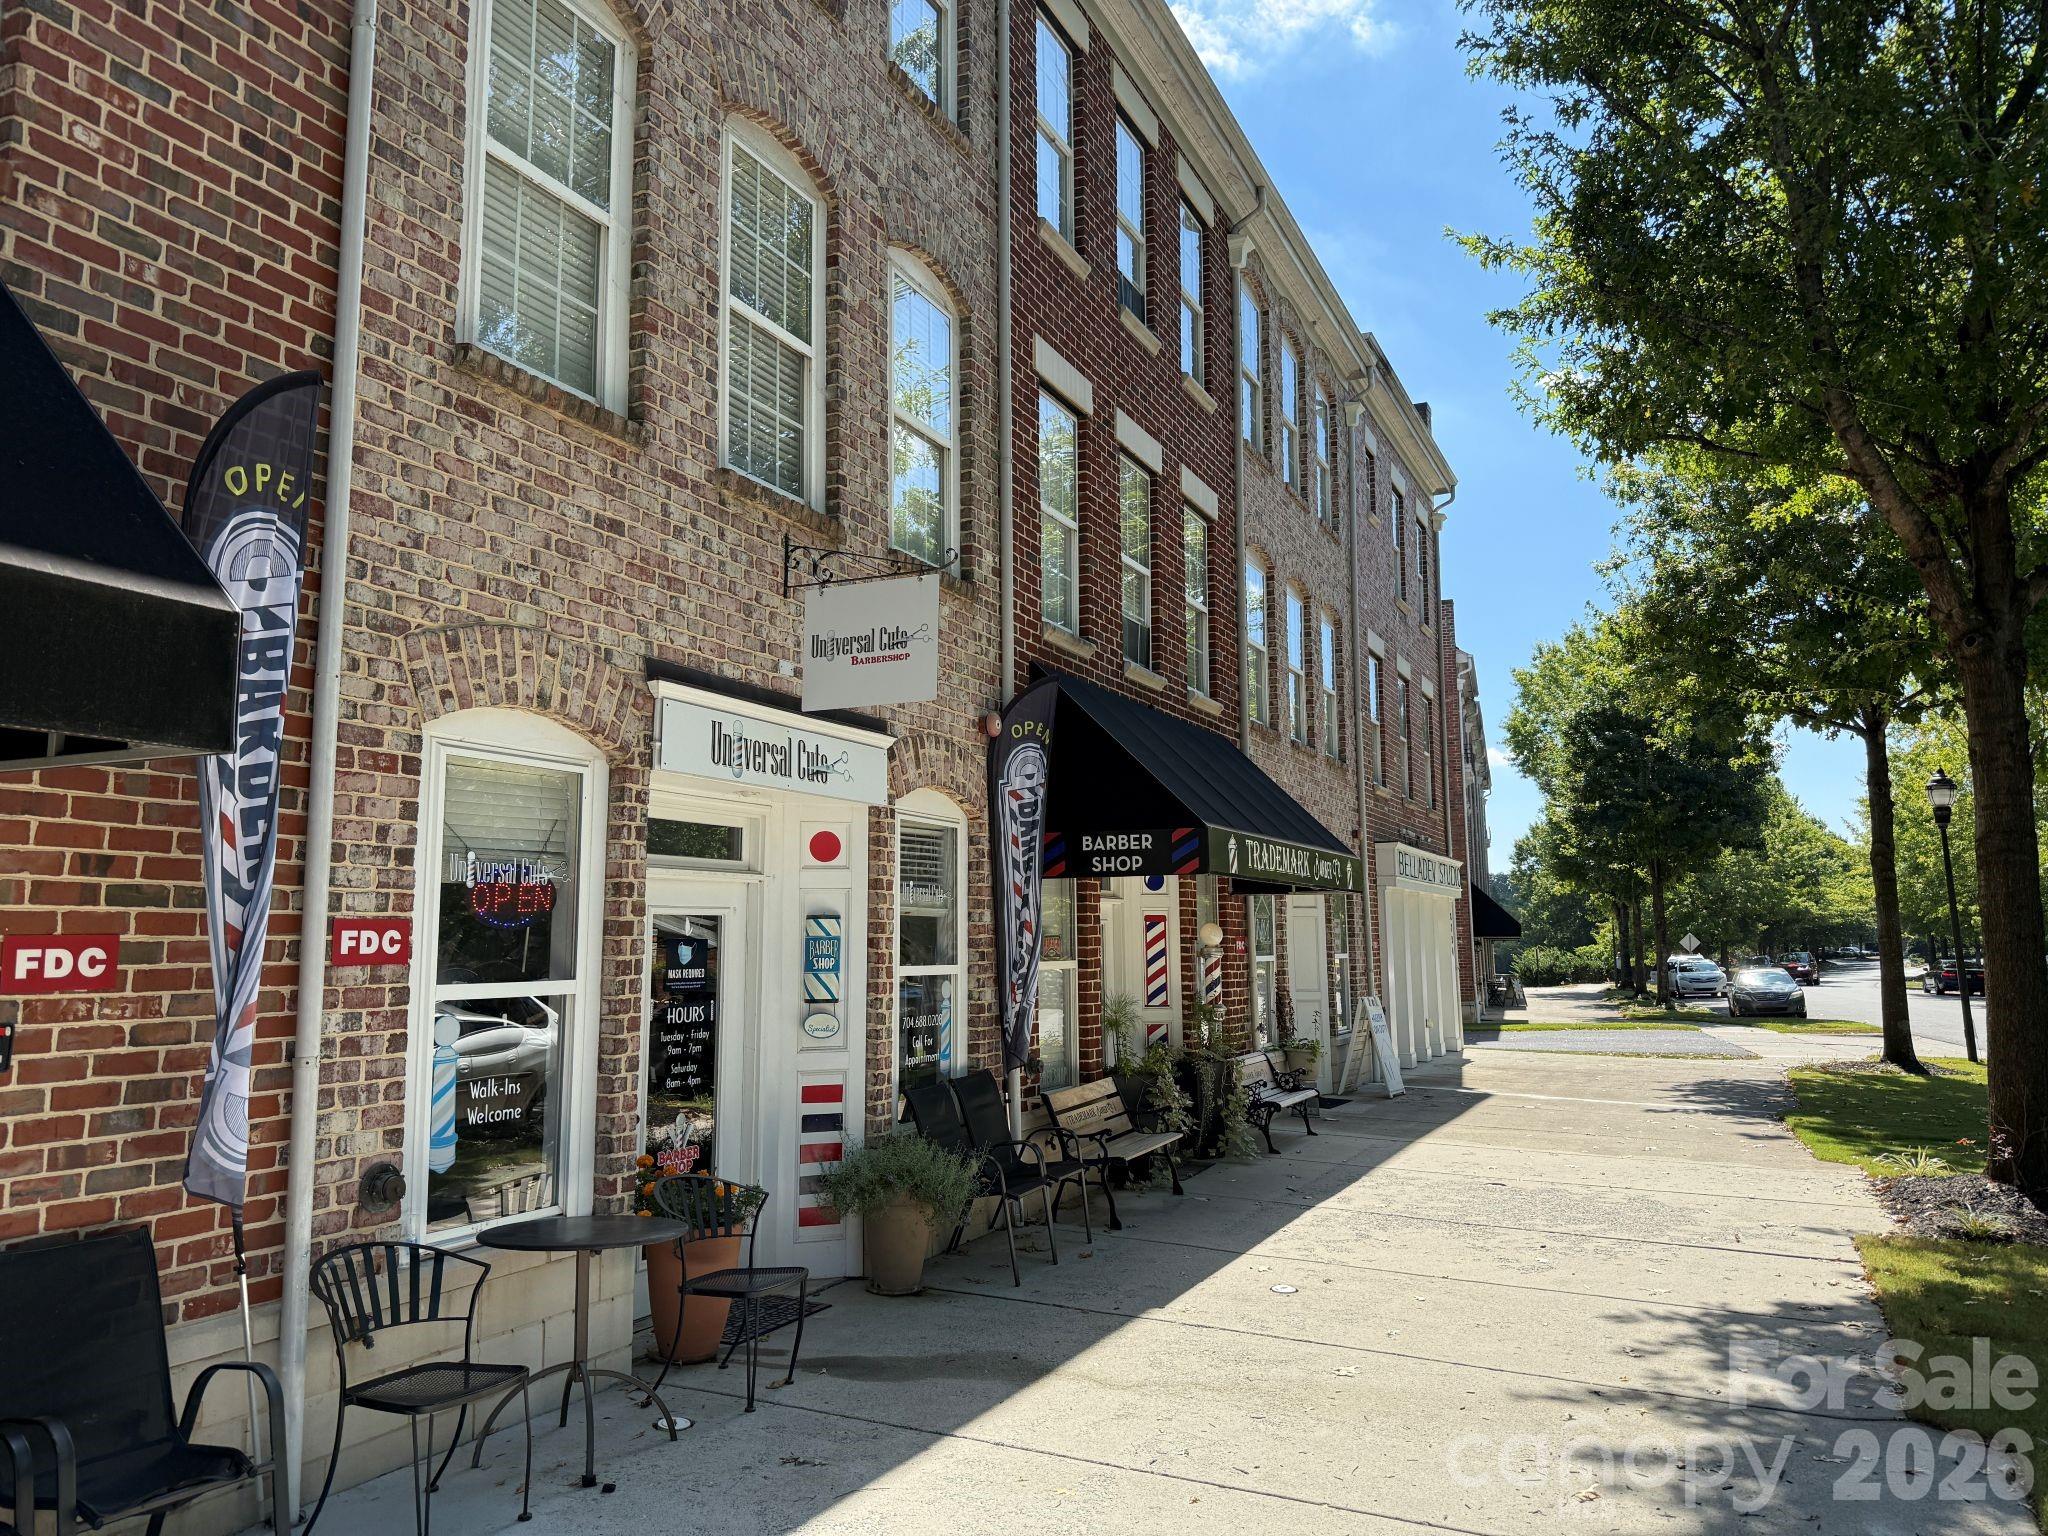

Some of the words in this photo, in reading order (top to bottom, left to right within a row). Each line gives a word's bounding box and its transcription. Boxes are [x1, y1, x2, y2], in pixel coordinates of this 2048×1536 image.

[810, 628, 875, 662] Universal
[879, 625, 908, 652] Cuts
[850, 652, 911, 666] BARBERSHOP
[711, 719, 792, 779] Universal
[797, 739, 828, 784] Cuts
[1082, 833, 1153, 851] BARBER
[1092, 855, 1143, 872] SHOP
[1245, 839, 1311, 878] TRADEMARK
[449, 851, 518, 888] Universal
[521, 857, 548, 886] Cuts
[472, 882, 552, 912] OPEN
[340, 929, 402, 955] FDC
[809, 939, 839, 961] BARBER
[14, 947, 108, 980] FDC
[812, 957, 835, 970] SHOP
[667, 968, 682, 979] MASK
[682, 968, 705, 979] REQUIRED
[666, 1005, 705, 1024] HOURS
[660, 1030, 685, 1043] Tuesday
[690, 1028, 710, 1040] Friday
[807, 1023, 836, 1036] Specialist
[667, 1045, 682, 1055] 9am
[688, 1042, 702, 1055] 7pm
[912, 1034, 923, 1048] Call
[924, 1034, 933, 1046] For
[670, 1061, 698, 1074] Saturday
[904, 1048, 940, 1068] Appointment
[470, 1077, 521, 1099] Walk-Ins
[666, 1077, 681, 1088] 8am
[687, 1075, 701, 1087] 4pm
[467, 1103, 522, 1125] Welcome
[657, 1145, 700, 1167] BARBER
